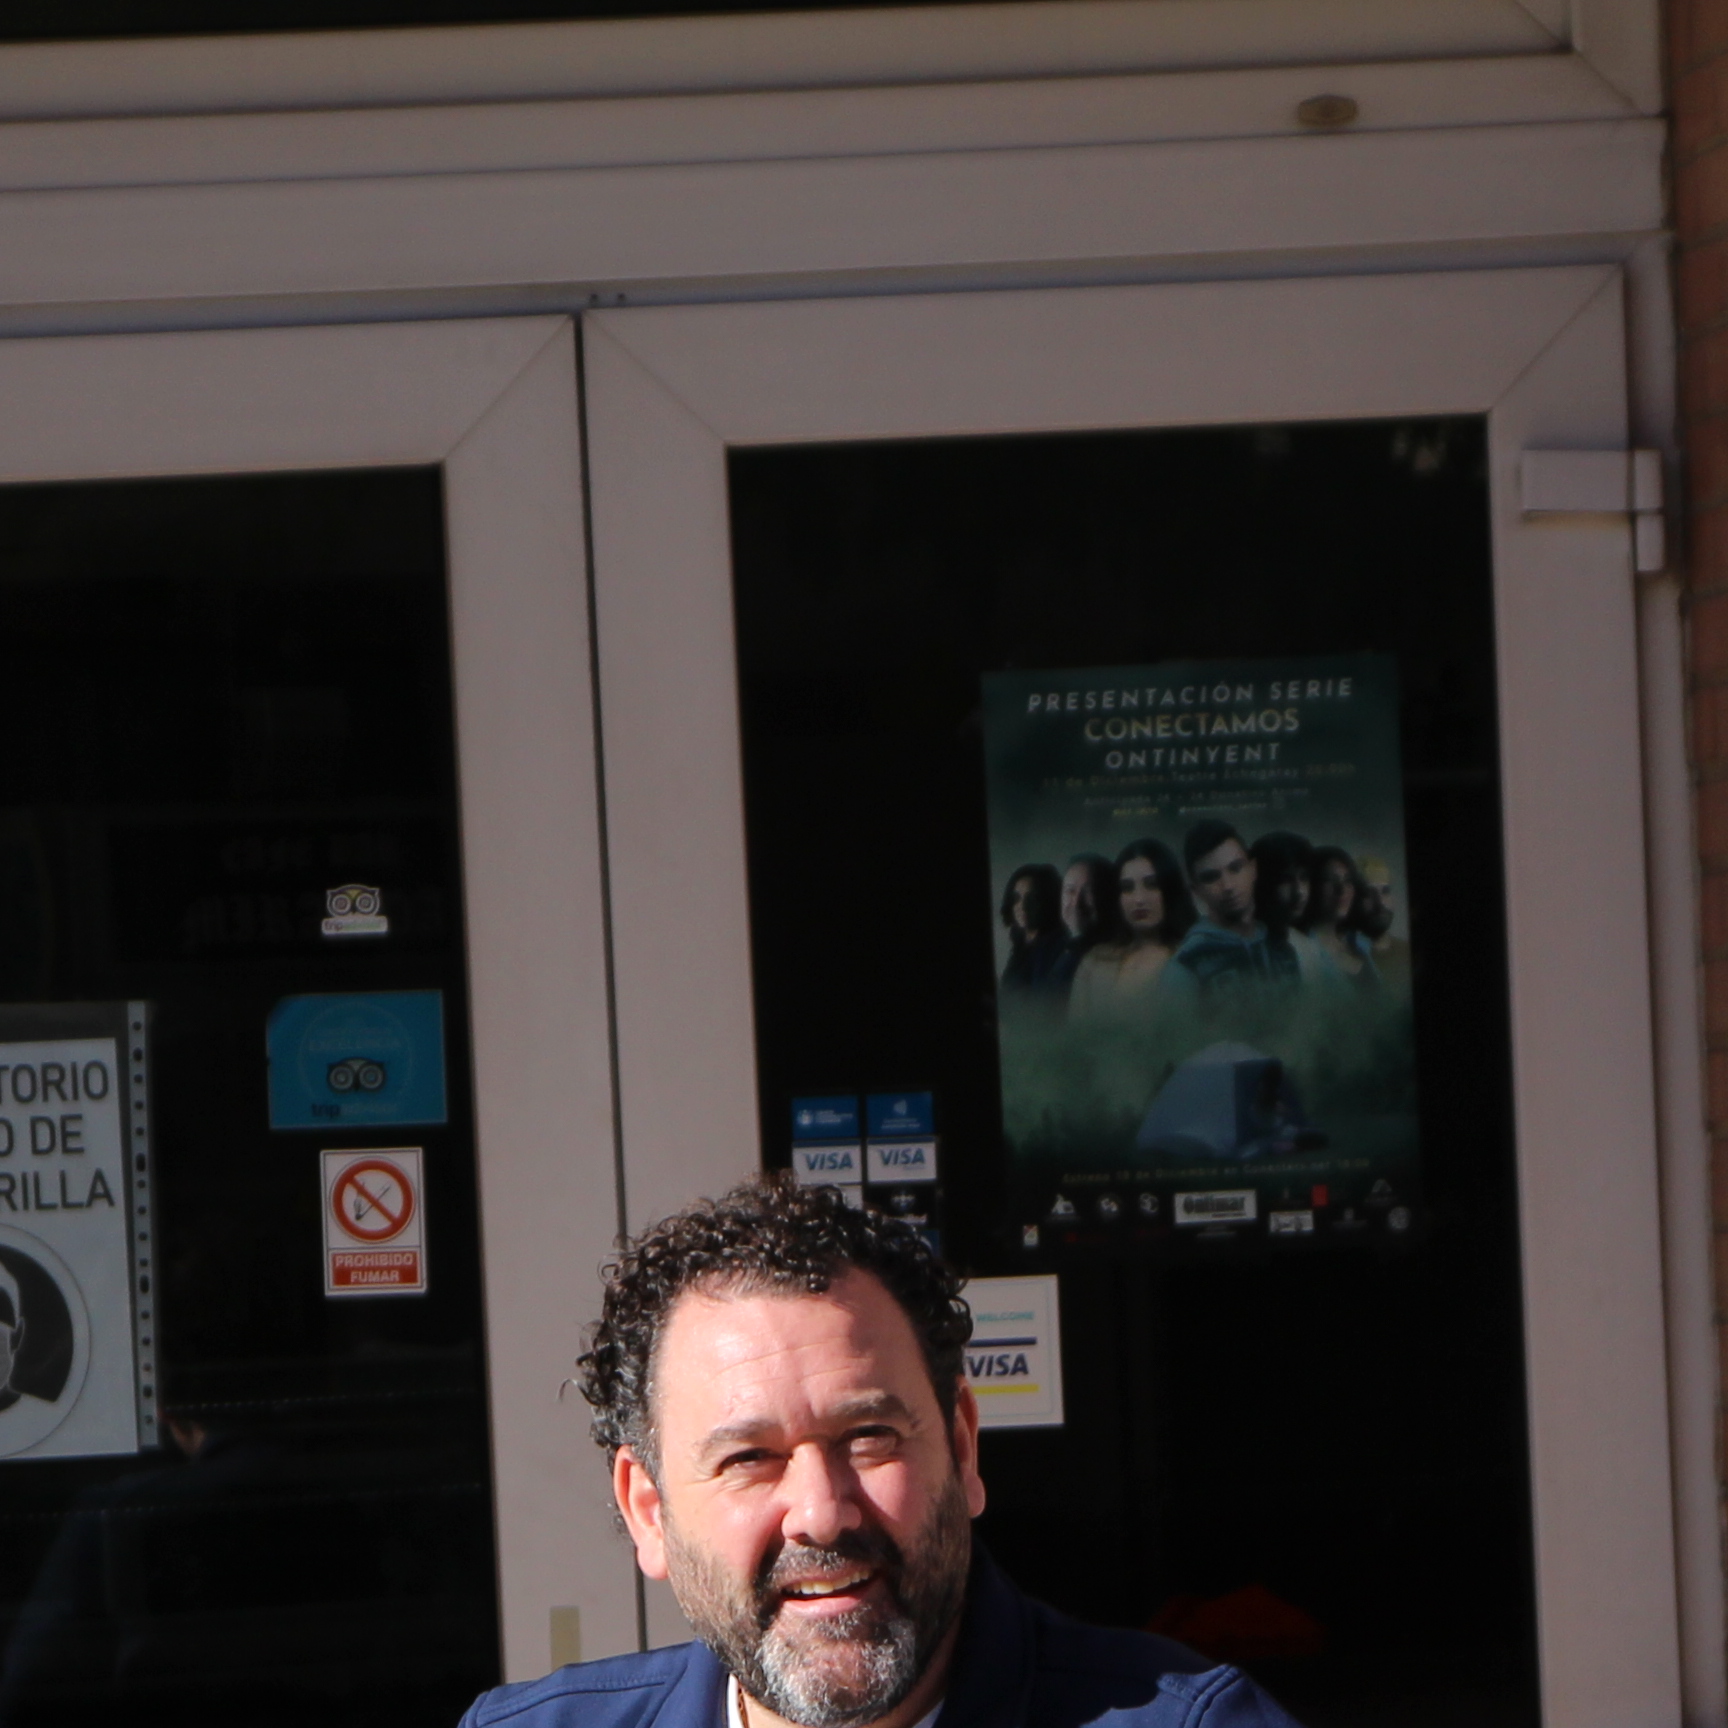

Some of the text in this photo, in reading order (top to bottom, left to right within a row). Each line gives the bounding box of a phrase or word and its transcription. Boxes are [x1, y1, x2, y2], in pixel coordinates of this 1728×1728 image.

[1026, 677, 1355, 714] PRESENTACIÓN SERIE
[1084, 708, 1300, 742] CONECTAMOS
[1104, 742, 1282, 770] ONTINYENT
[30, 1114, 85, 1155] DE
[803, 1151, 853, 1170] VISA
[878, 1147, 926, 1165] VISA
[335, 1252, 414, 1268] PROHIBIDO
[350, 1270, 400, 1283] FUMAR
[966, 1353, 1029, 1378] VISA
